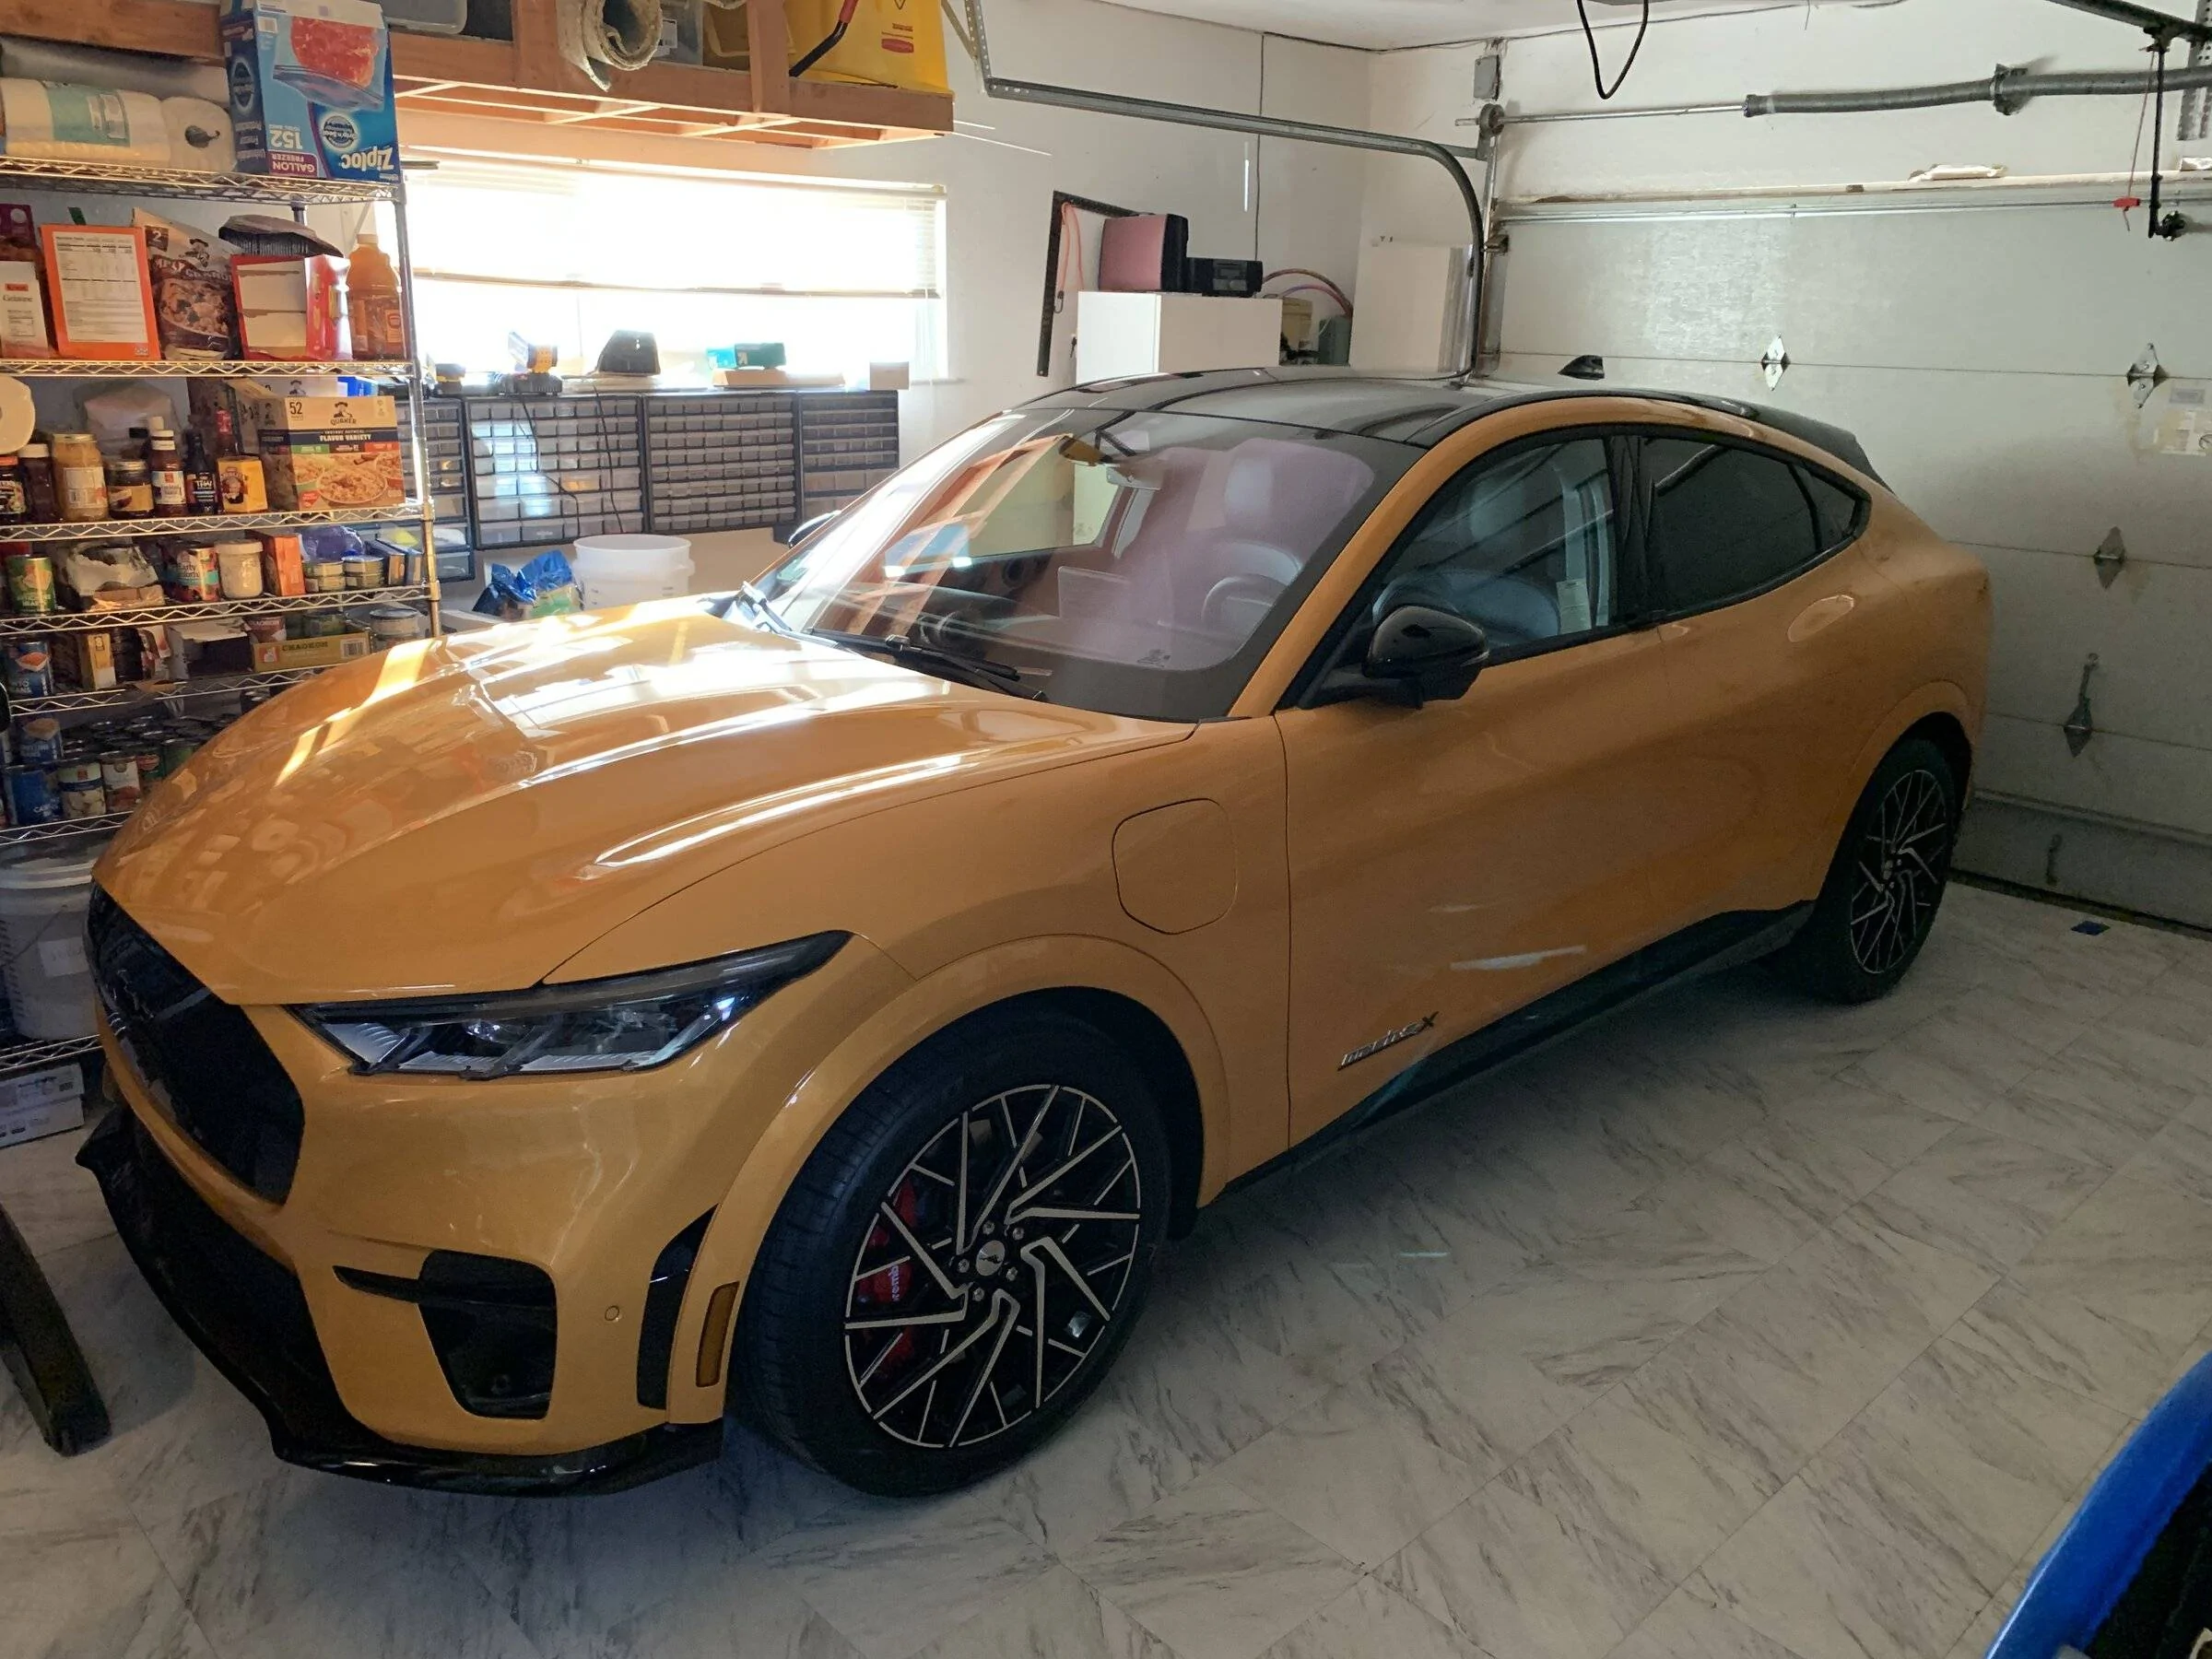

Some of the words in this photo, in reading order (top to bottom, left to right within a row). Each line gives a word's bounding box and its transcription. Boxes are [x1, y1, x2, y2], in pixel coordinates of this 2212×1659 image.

[269, 129, 303, 150] 152
[272, 153, 304, 162] FREEZER
[341, 146, 394, 171] Ziploc
[273, 161, 315, 173] GALLON
[152, 230, 162, 242] 2
[289, 401, 303, 415] 52
[330, 418, 357, 426] QUAKER
[345, 433, 371, 441] VARIETY
